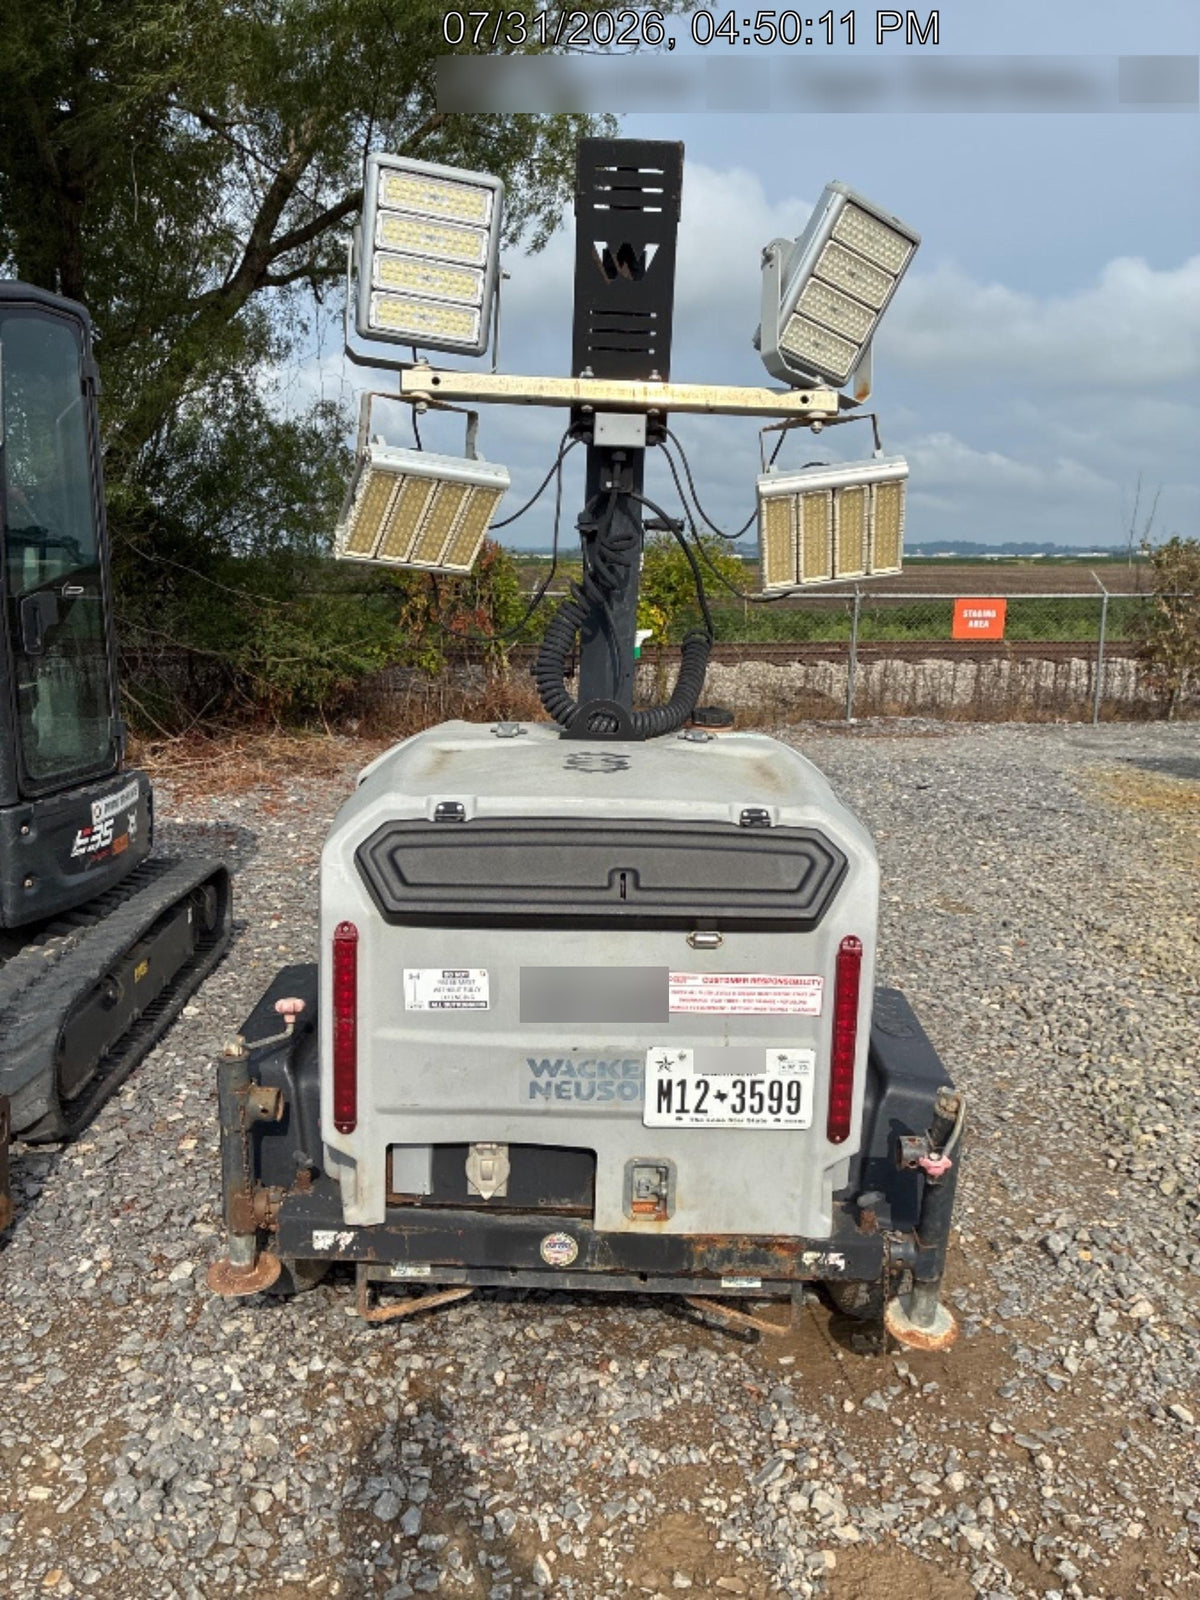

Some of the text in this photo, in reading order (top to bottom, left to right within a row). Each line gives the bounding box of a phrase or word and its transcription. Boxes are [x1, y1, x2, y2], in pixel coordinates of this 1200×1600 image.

[968, 620, 990, 628] AREA
[526, 1058, 645, 1079] WACKE
[529, 1080, 645, 1101] NEUSO
